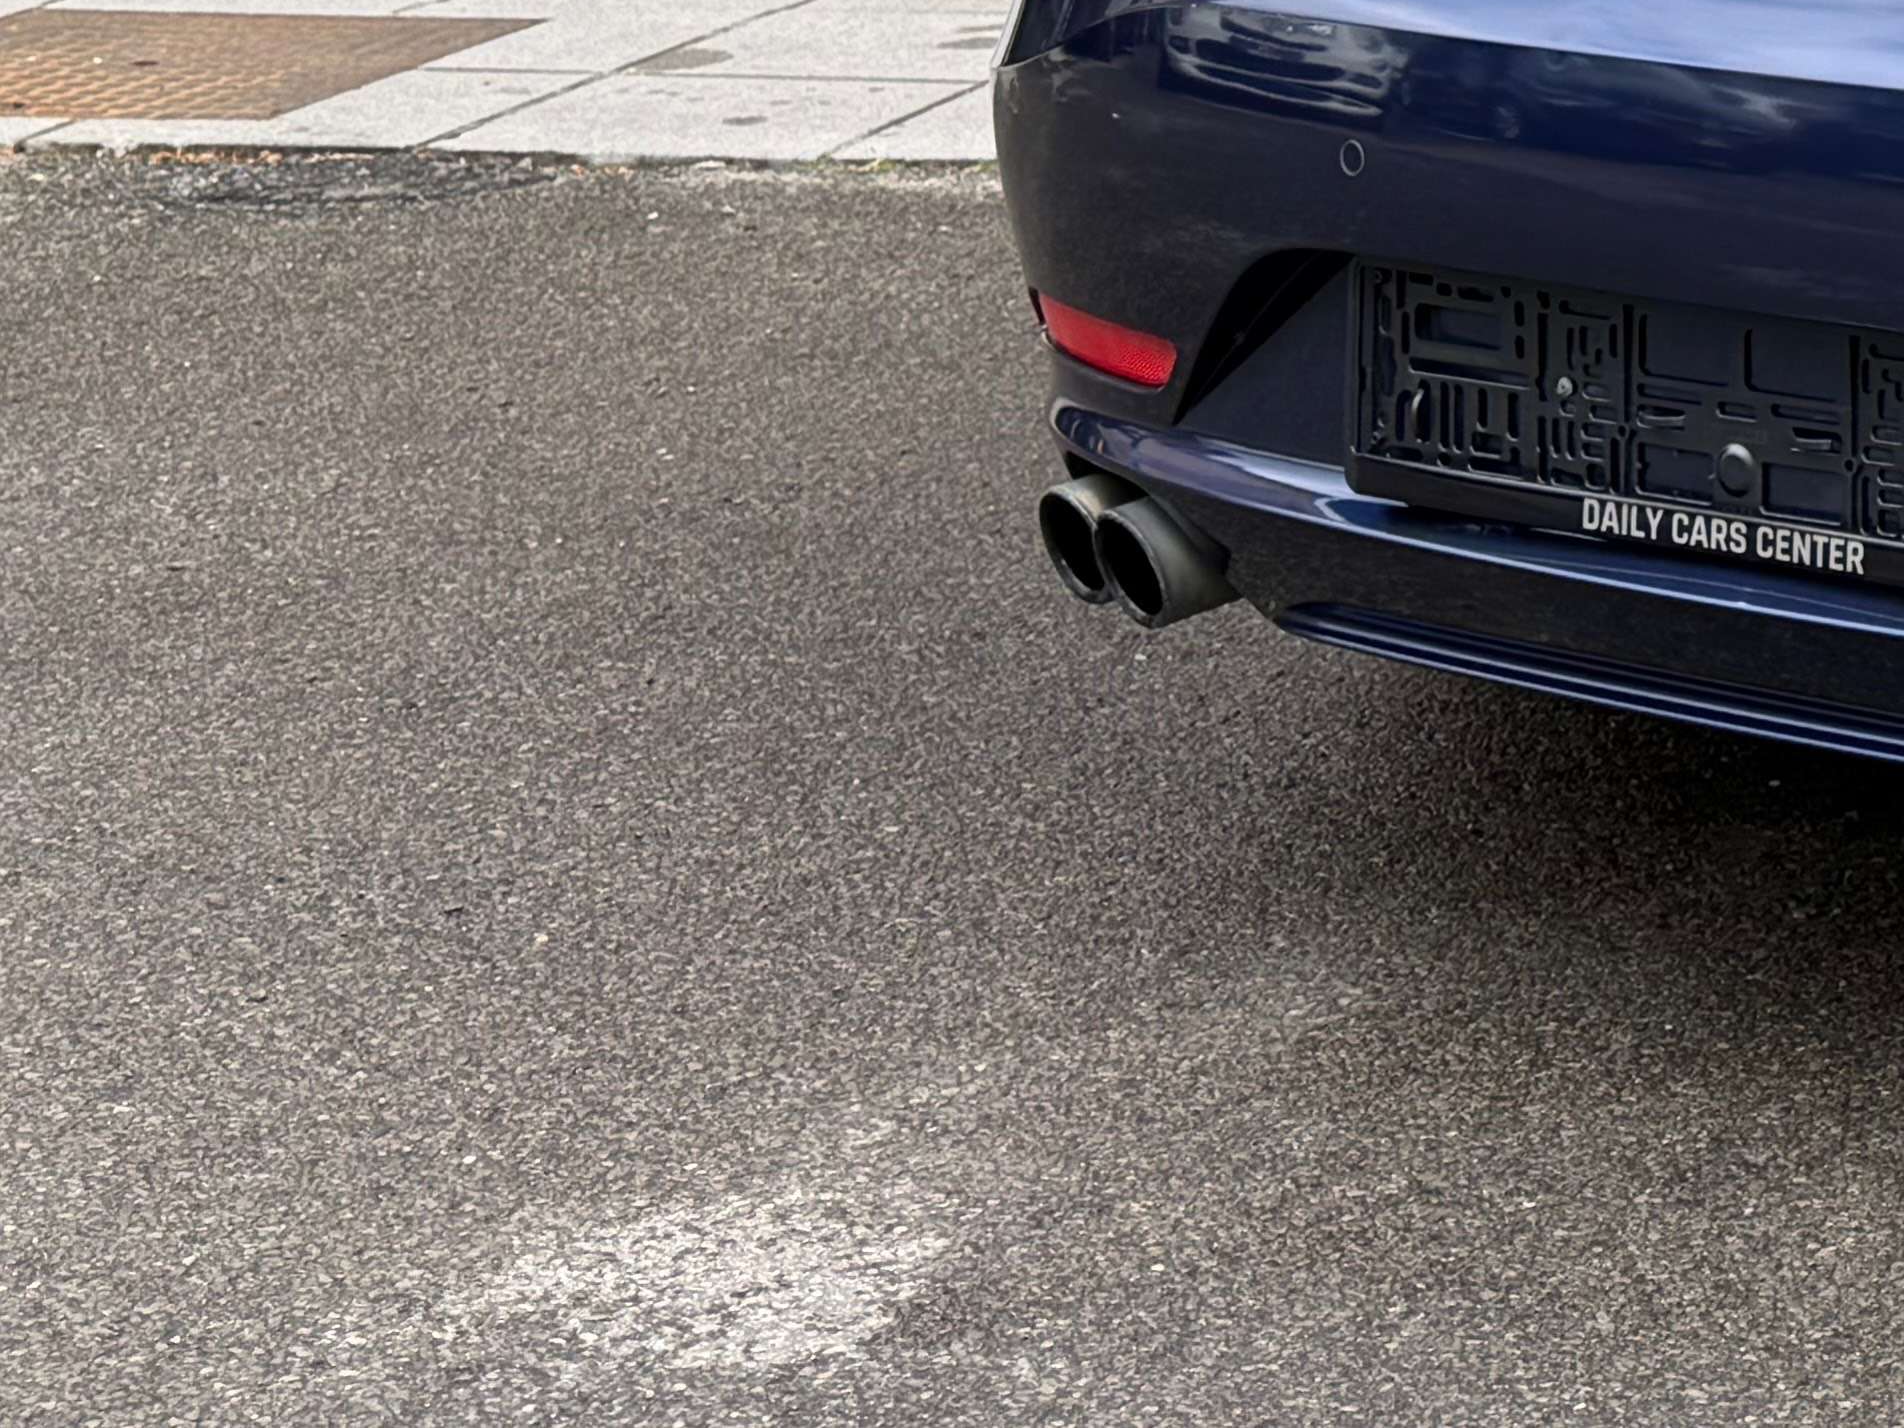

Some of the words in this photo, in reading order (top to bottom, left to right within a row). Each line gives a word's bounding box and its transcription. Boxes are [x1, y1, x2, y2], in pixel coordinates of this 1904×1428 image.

[1582, 497, 1664, 540] DAILY
[1671, 512, 1748, 554] CARS
[1756, 525, 1865, 575] CENTER
